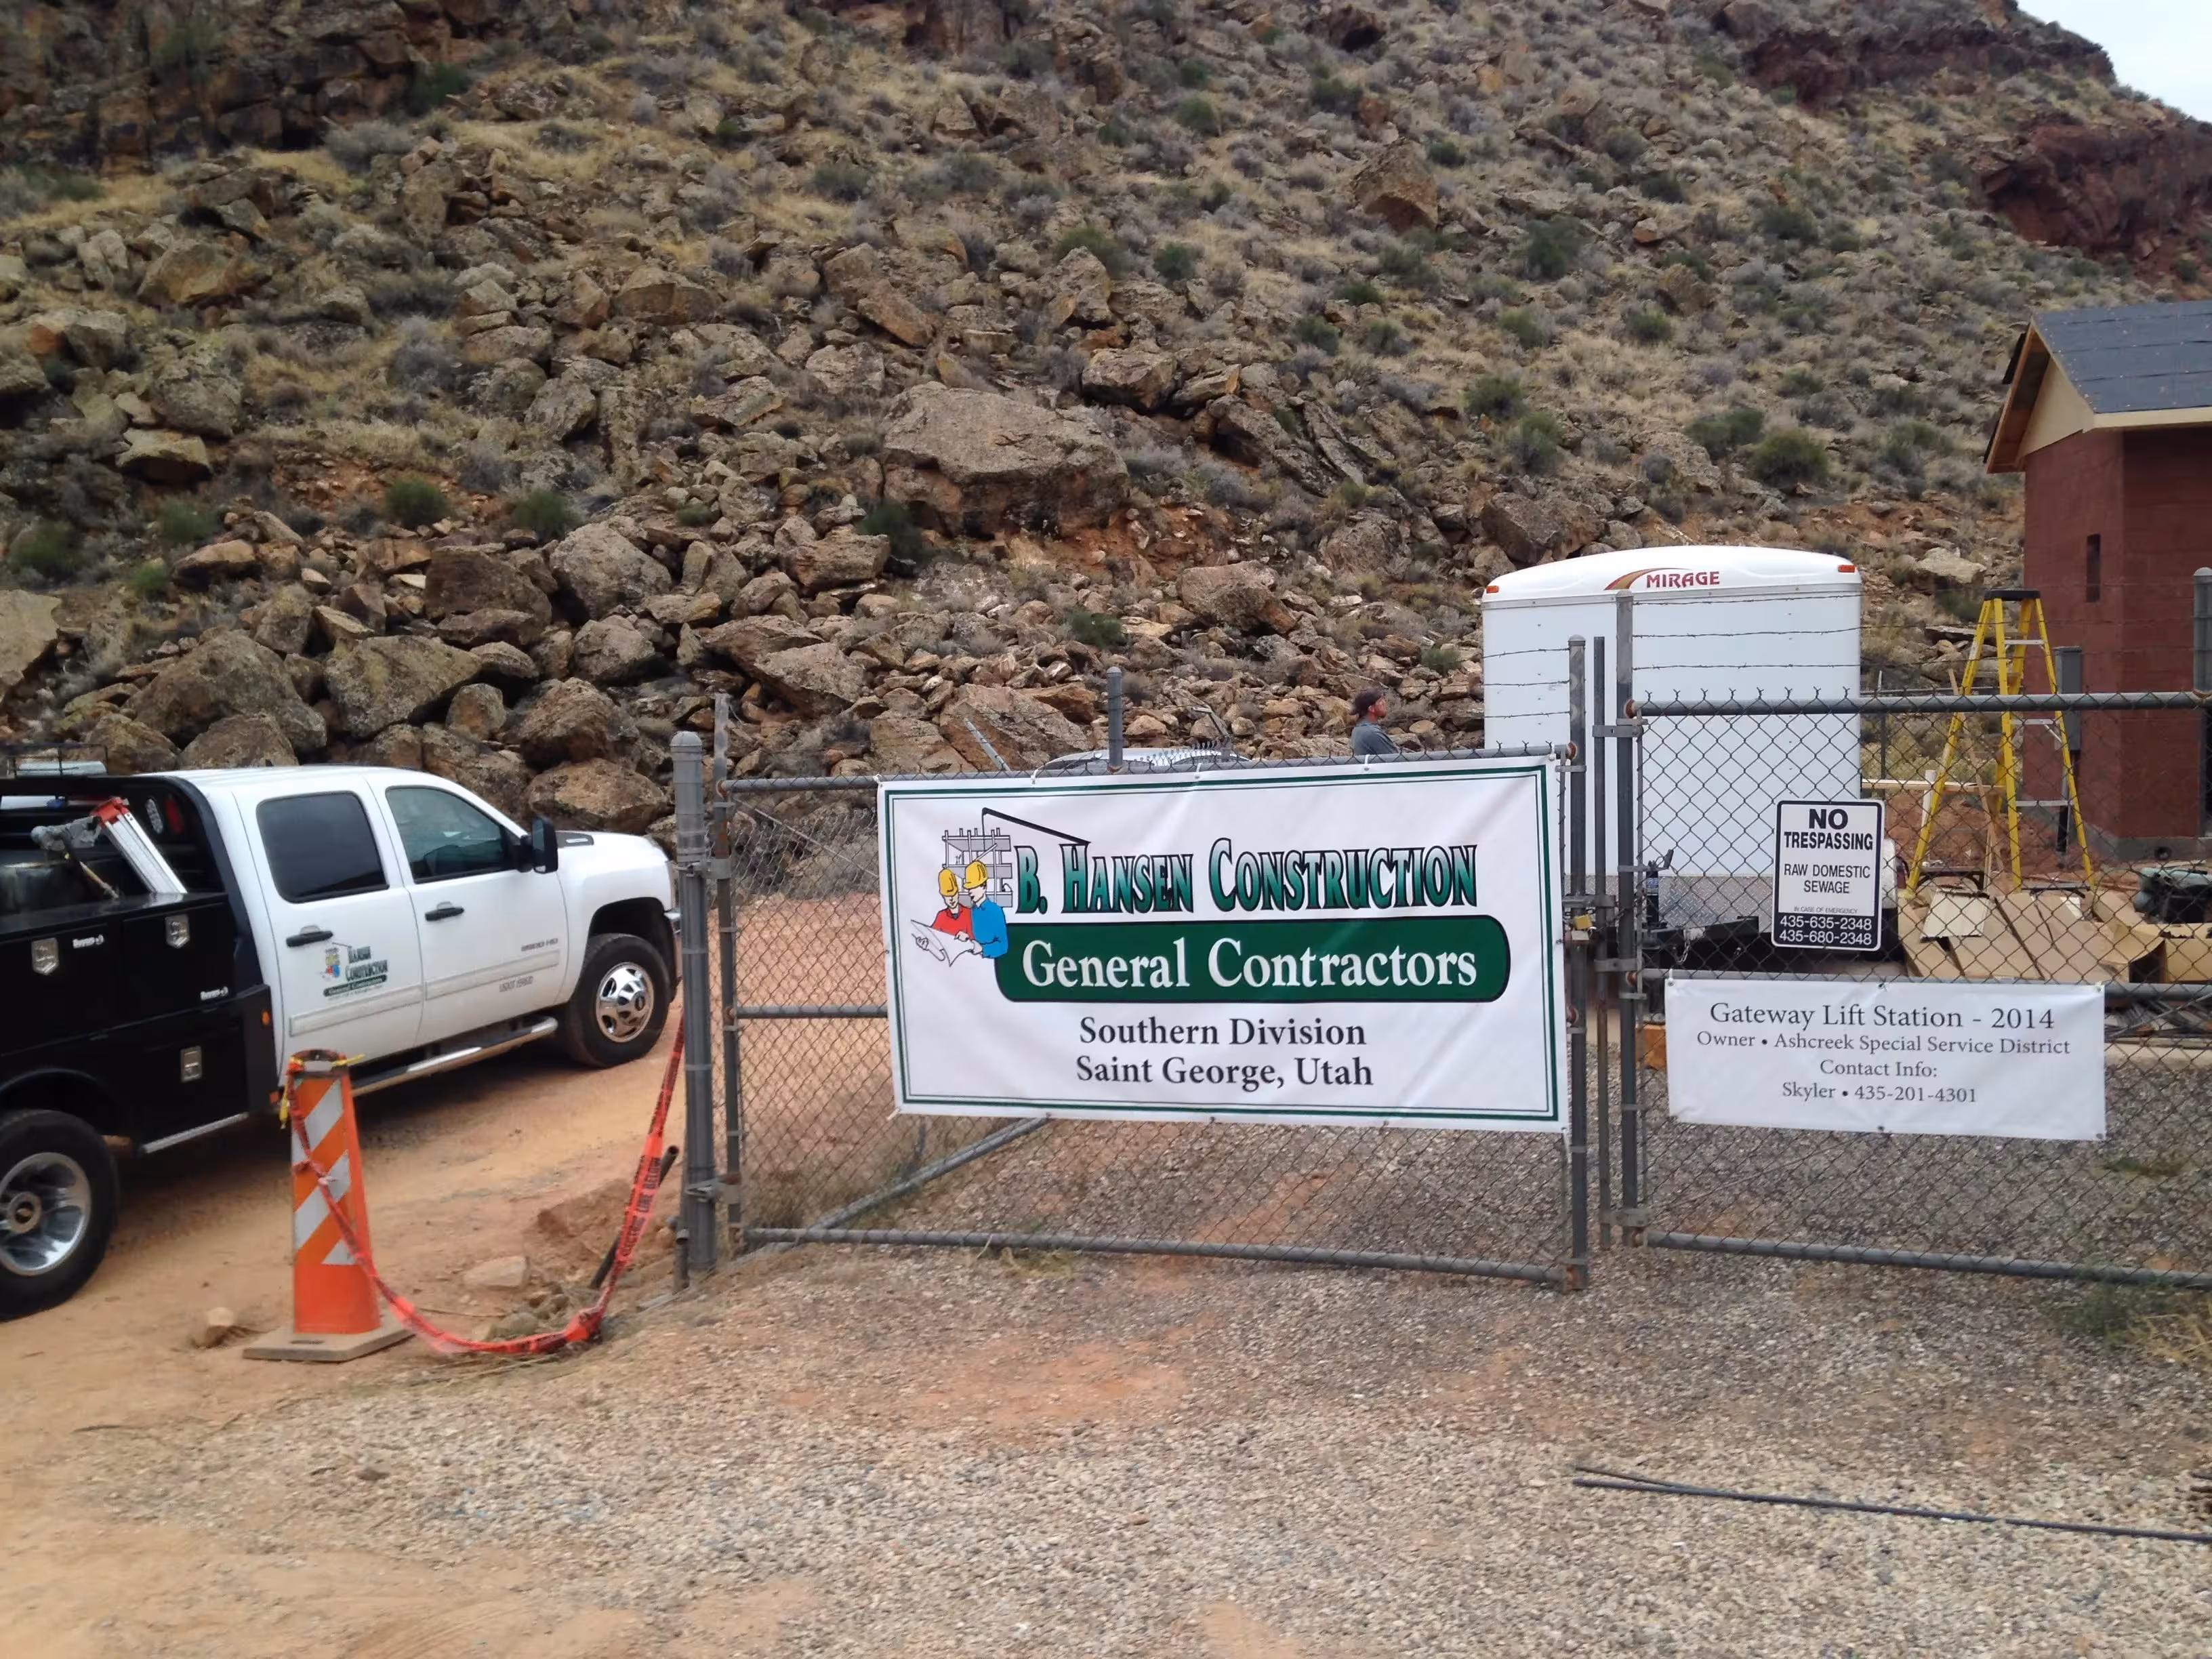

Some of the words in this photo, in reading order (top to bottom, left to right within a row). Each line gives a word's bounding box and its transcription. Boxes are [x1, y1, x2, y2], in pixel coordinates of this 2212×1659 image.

[1646, 571, 1721, 589] MIRAGE
[1809, 808, 1849, 830] NO
[1784, 832, 1873, 851] TRESPASSING
[1014, 846, 1048, 915] B.
[1061, 842, 1194, 914] HANSEN
[1209, 838, 1478, 912] CONSTRUCTION
[1784, 863, 1808, 876] RAW
[1812, 864, 1870, 878] DOMESTIC
[1803, 880, 1850, 894] SEWAGE
[1780, 915, 1872, 930] 435-635-2348
[1779, 930, 1872, 945] 435-680-2348
[1022, 937, 1191, 989] General
[1208, 937, 1477, 987] Contractors
[1710, 1002, 1816, 1031] Gateway
[1823, 1004, 1866, 1026] Lift
[1874, 1005, 1963, 1028] Station
[1991, 1008, 2055, 1029] 2014
[1080, 1016, 1220, 1045] Southern
[1229, 1017, 1368, 1046] Division
[1697, 1031, 1756, 1047] Owner
[1774, 1031, 1855, 1050] Ashcreek
[1860, 1034, 1921, 1054] Special
[1927, 1036, 1994, 1054] Service
[2000, 1038, 2071, 1054] District
[1076, 1055, 1153, 1084] Saint
[1162, 1056, 1285, 1092] George,
[1294, 1057, 1374, 1086] Utah
[1820, 1059, 1890, 1077] Contact
[1896, 1061, 1938, 1078] Info:
[1782, 1082, 1837, 1102] Skyler
[1854, 1085, 1978, 1103] 435-201-4301
